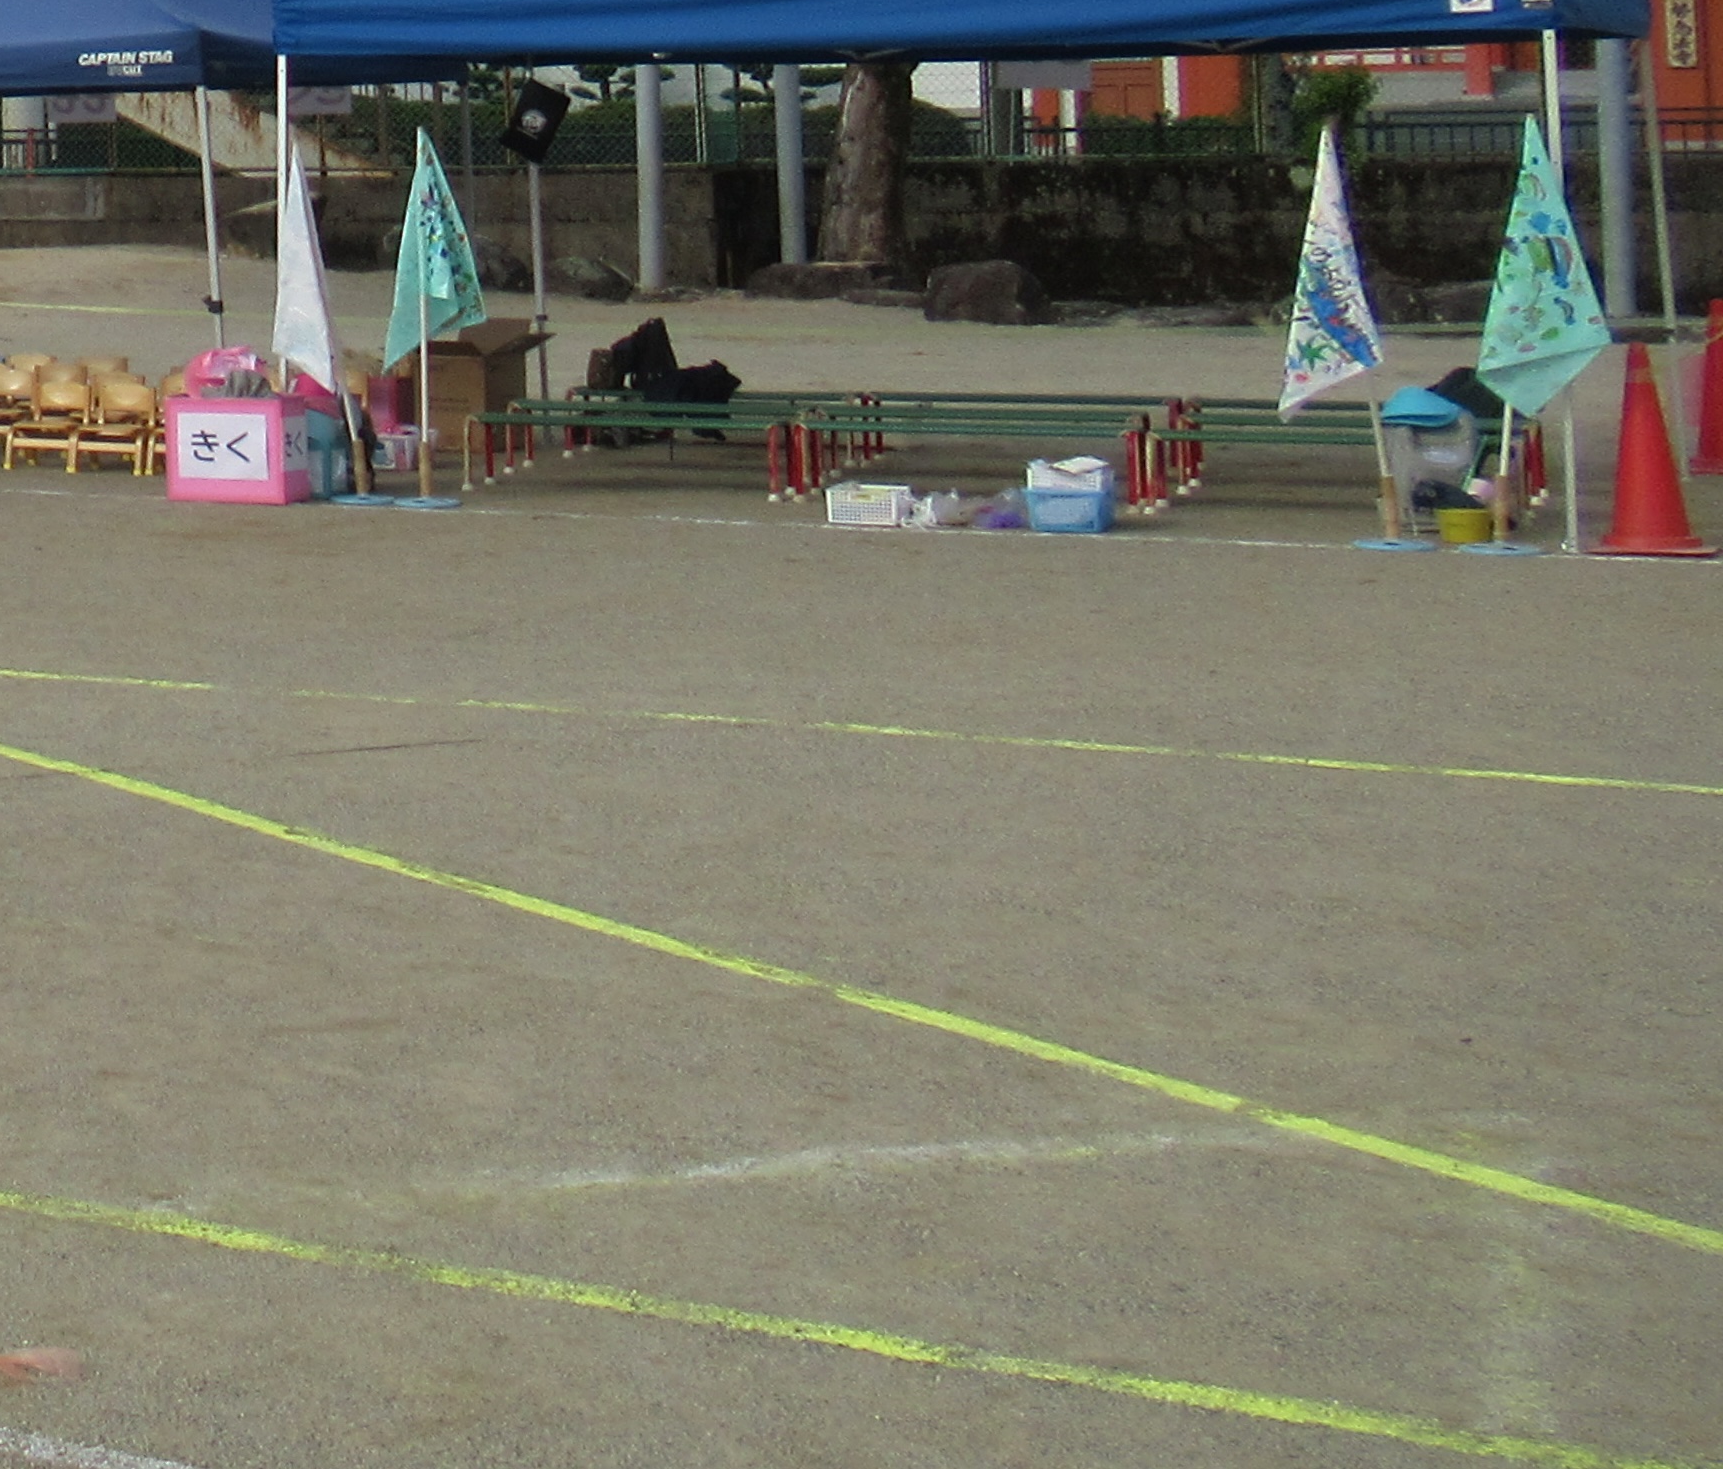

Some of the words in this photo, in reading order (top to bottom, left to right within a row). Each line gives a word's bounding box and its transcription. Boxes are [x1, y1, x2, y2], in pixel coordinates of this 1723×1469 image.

[78, 52, 137, 66] CAPTAIN
[138, 50, 174, 64] STAG
[191, 430, 251, 463] きく
